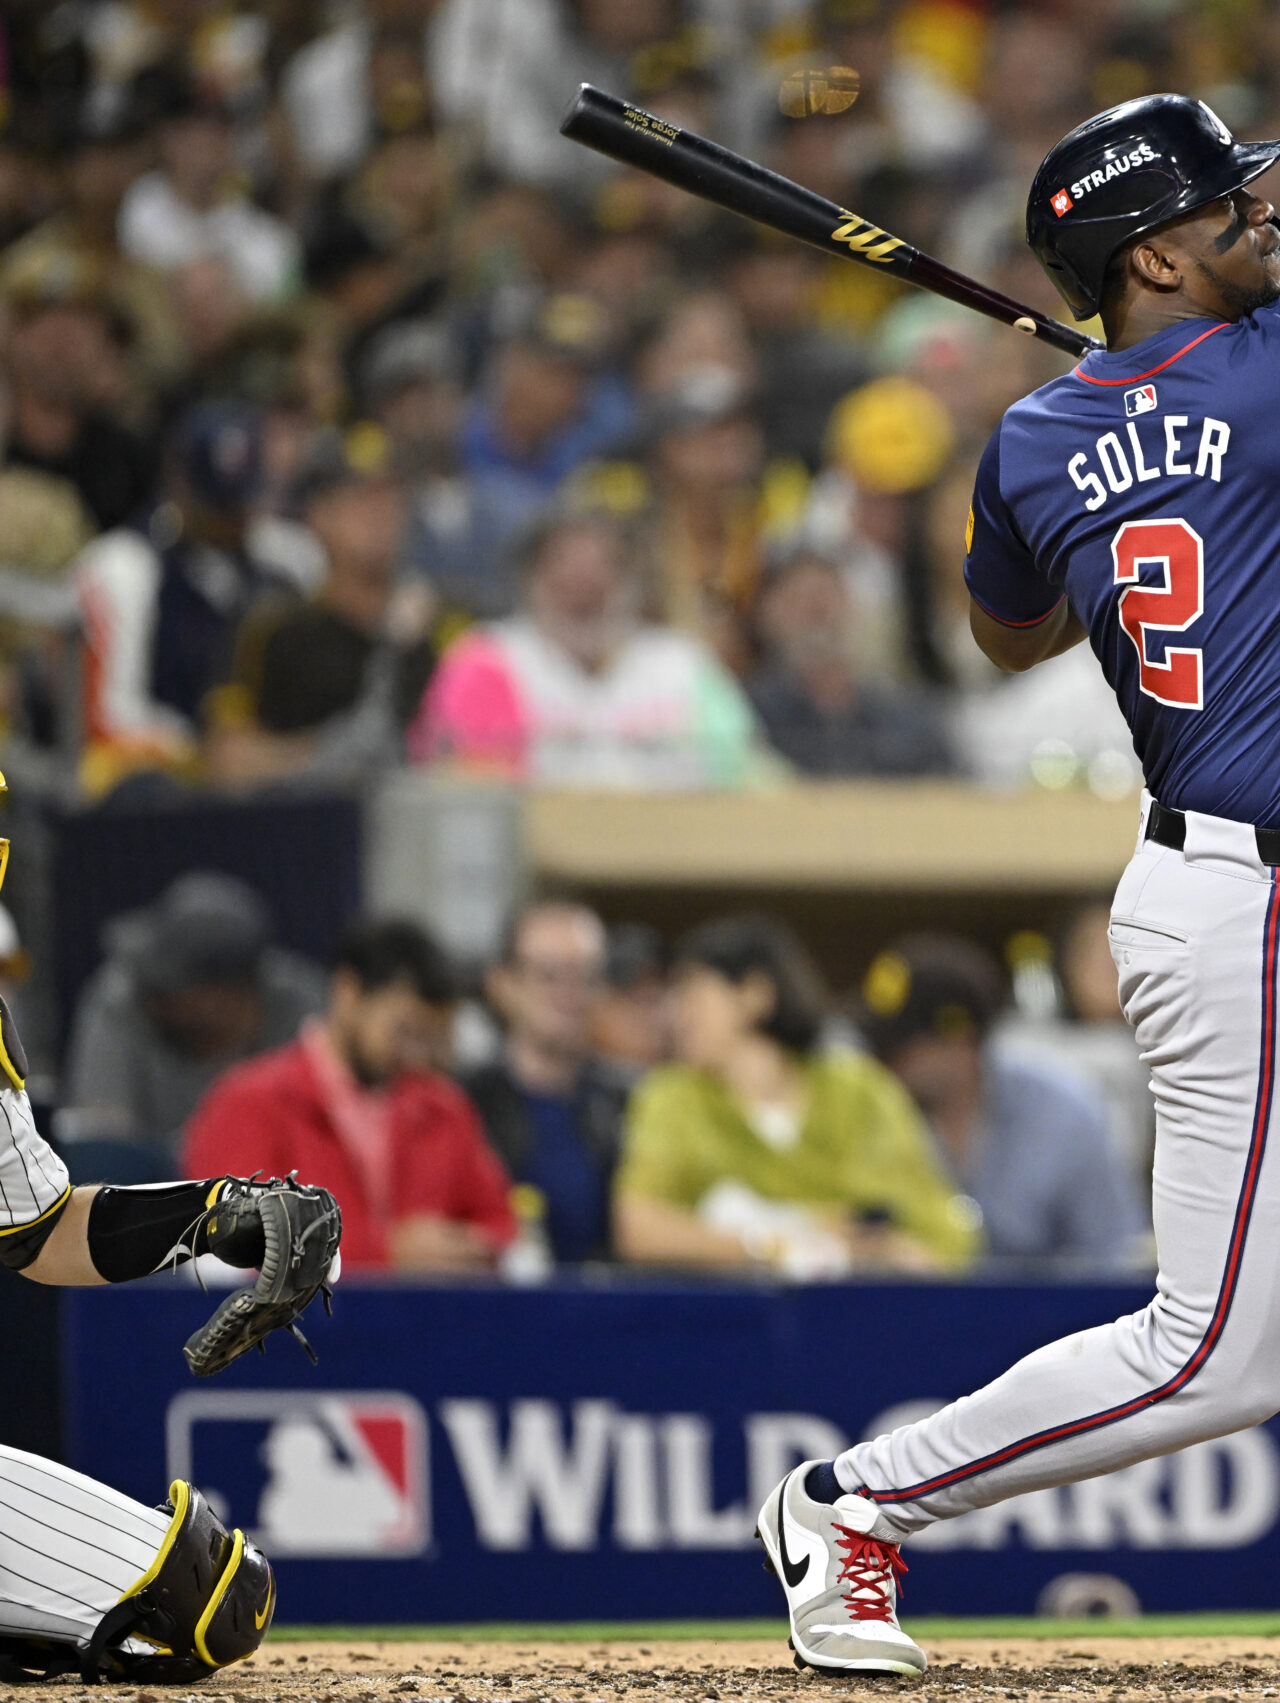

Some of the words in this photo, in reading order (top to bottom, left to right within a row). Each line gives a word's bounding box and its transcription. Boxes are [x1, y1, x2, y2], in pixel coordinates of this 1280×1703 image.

[624, 109, 650, 127] Soler
[651, 121, 679, 140] Jorge
[1071, 143, 1156, 200] STRAUSS
[1068, 415, 1231, 511] SOLER
[1111, 518, 1204, 711] 2
[442, 1399, 848, 1551] WILD
